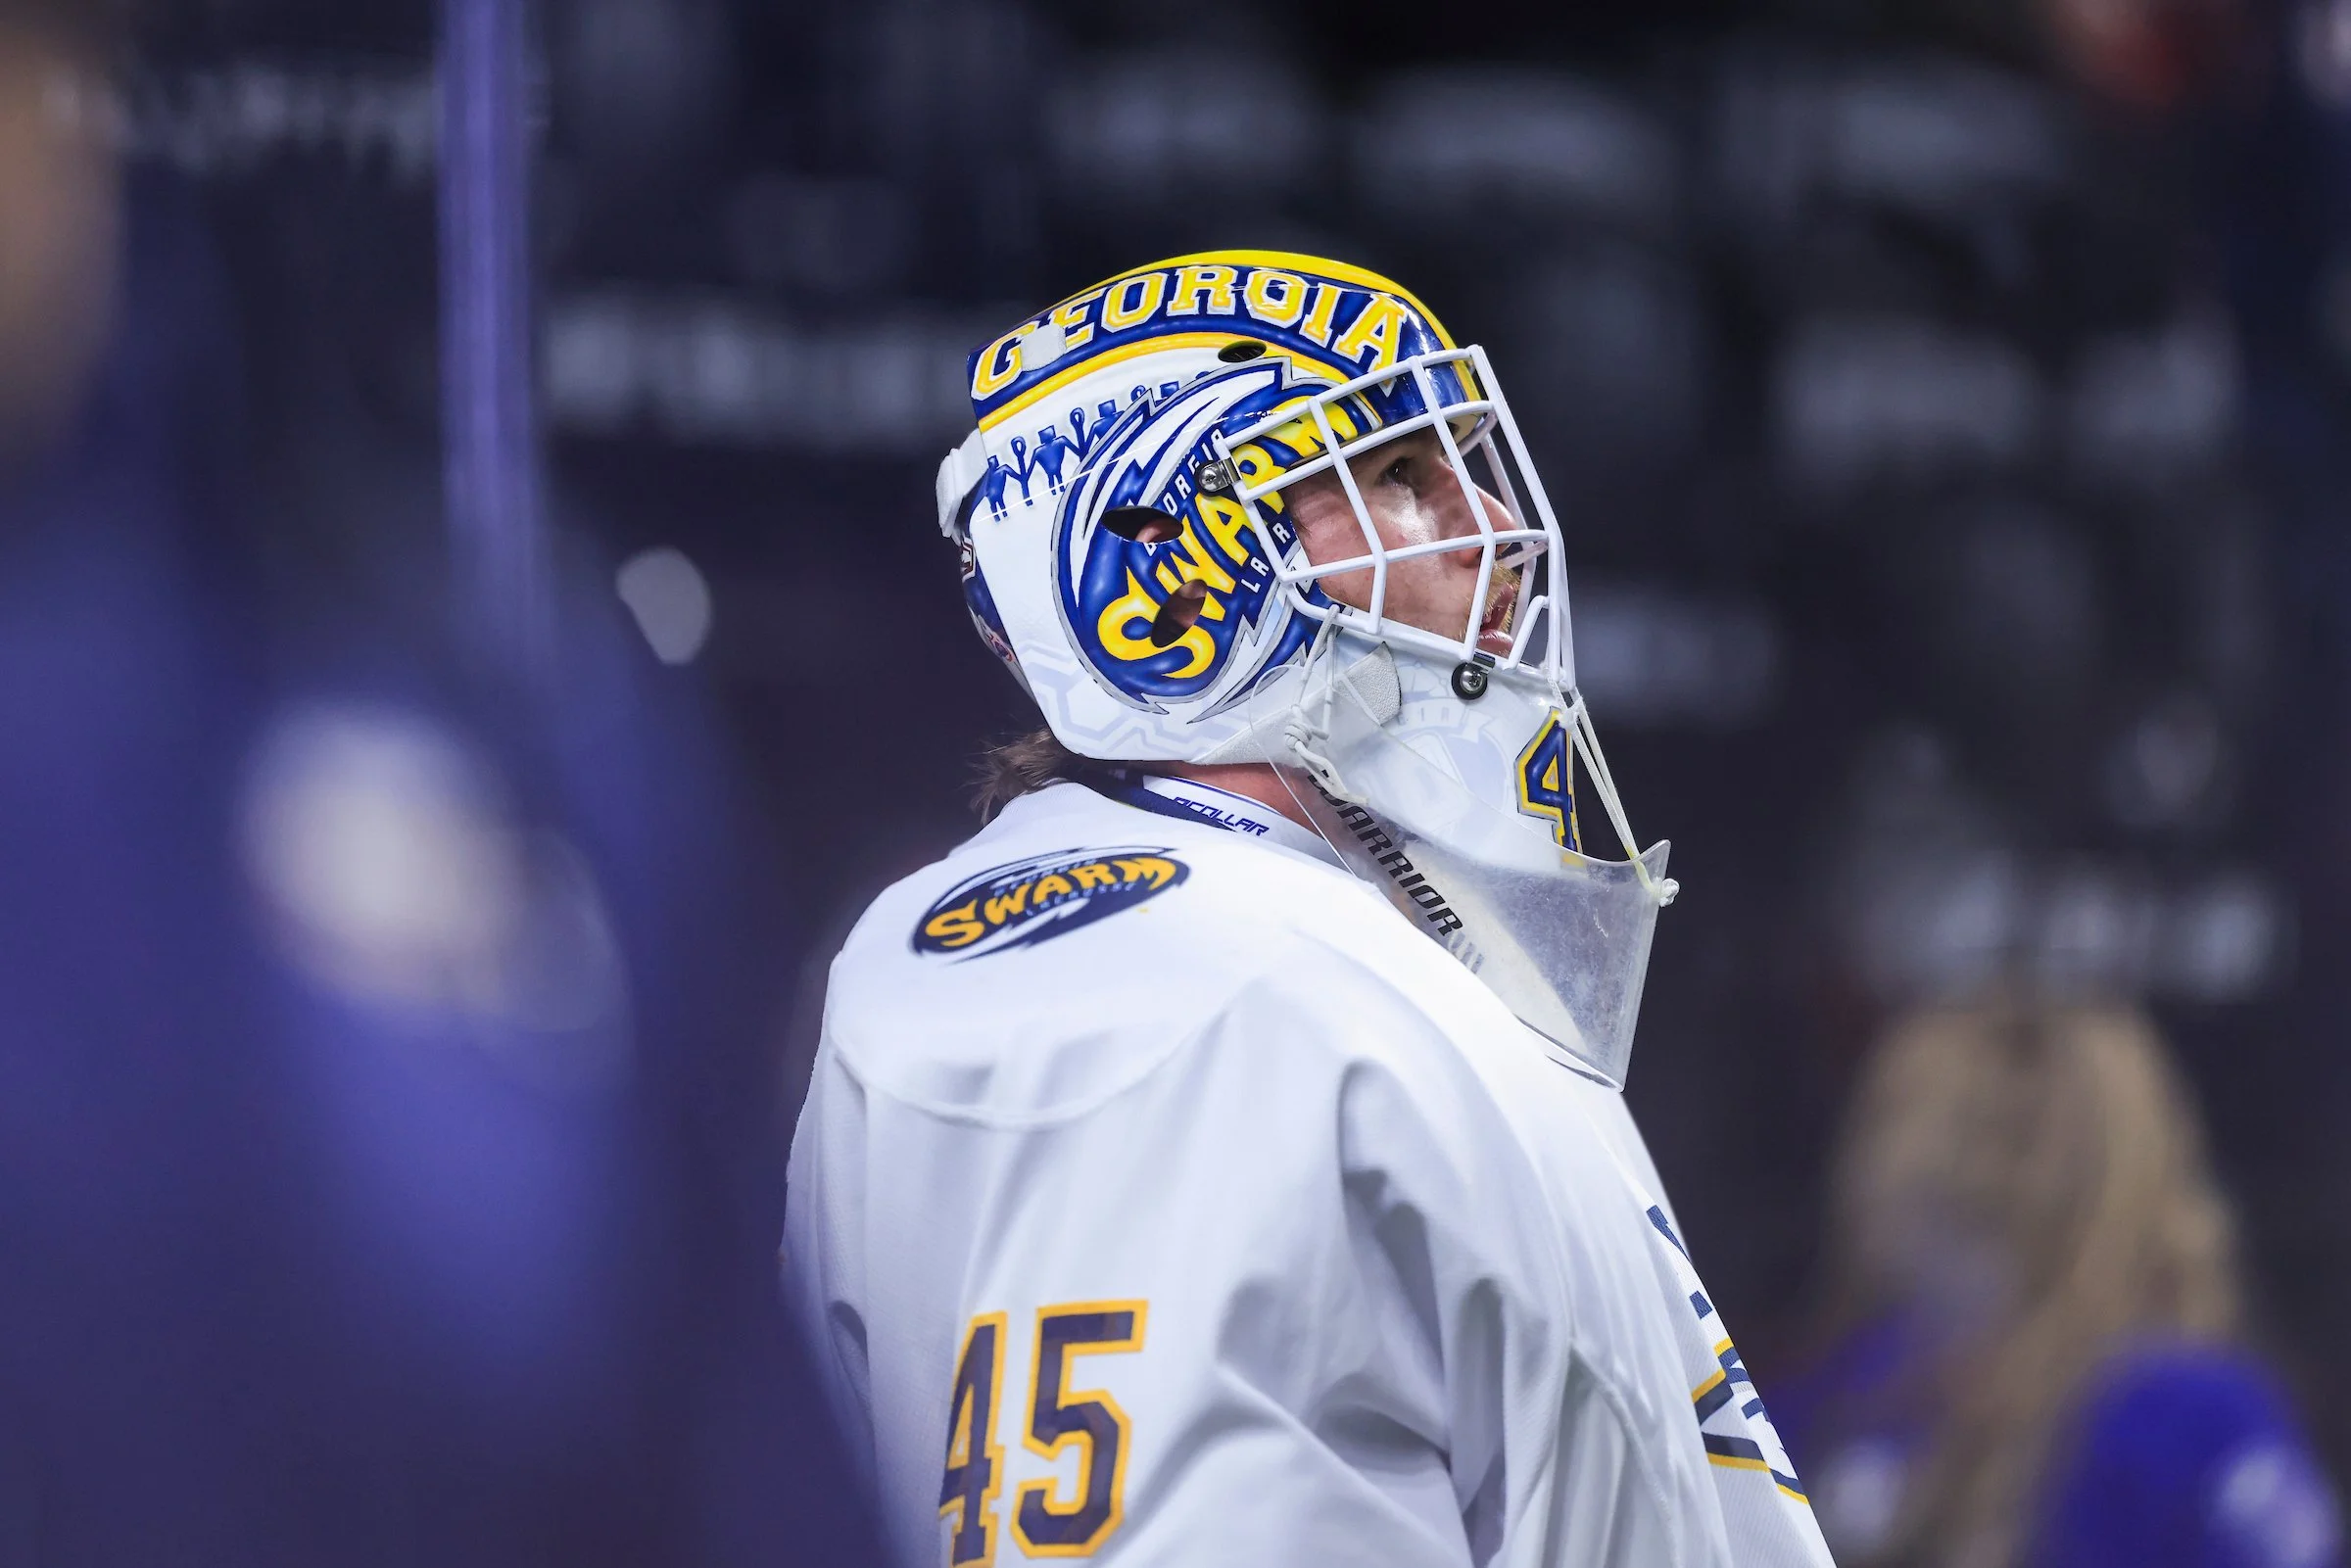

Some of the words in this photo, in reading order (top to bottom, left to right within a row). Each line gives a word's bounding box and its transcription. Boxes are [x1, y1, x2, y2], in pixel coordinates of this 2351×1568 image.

[970, 263, 1410, 401] GEORGIA
[925, 857, 1176, 947] SWARM
[938, 1299, 1150, 1568] 45
